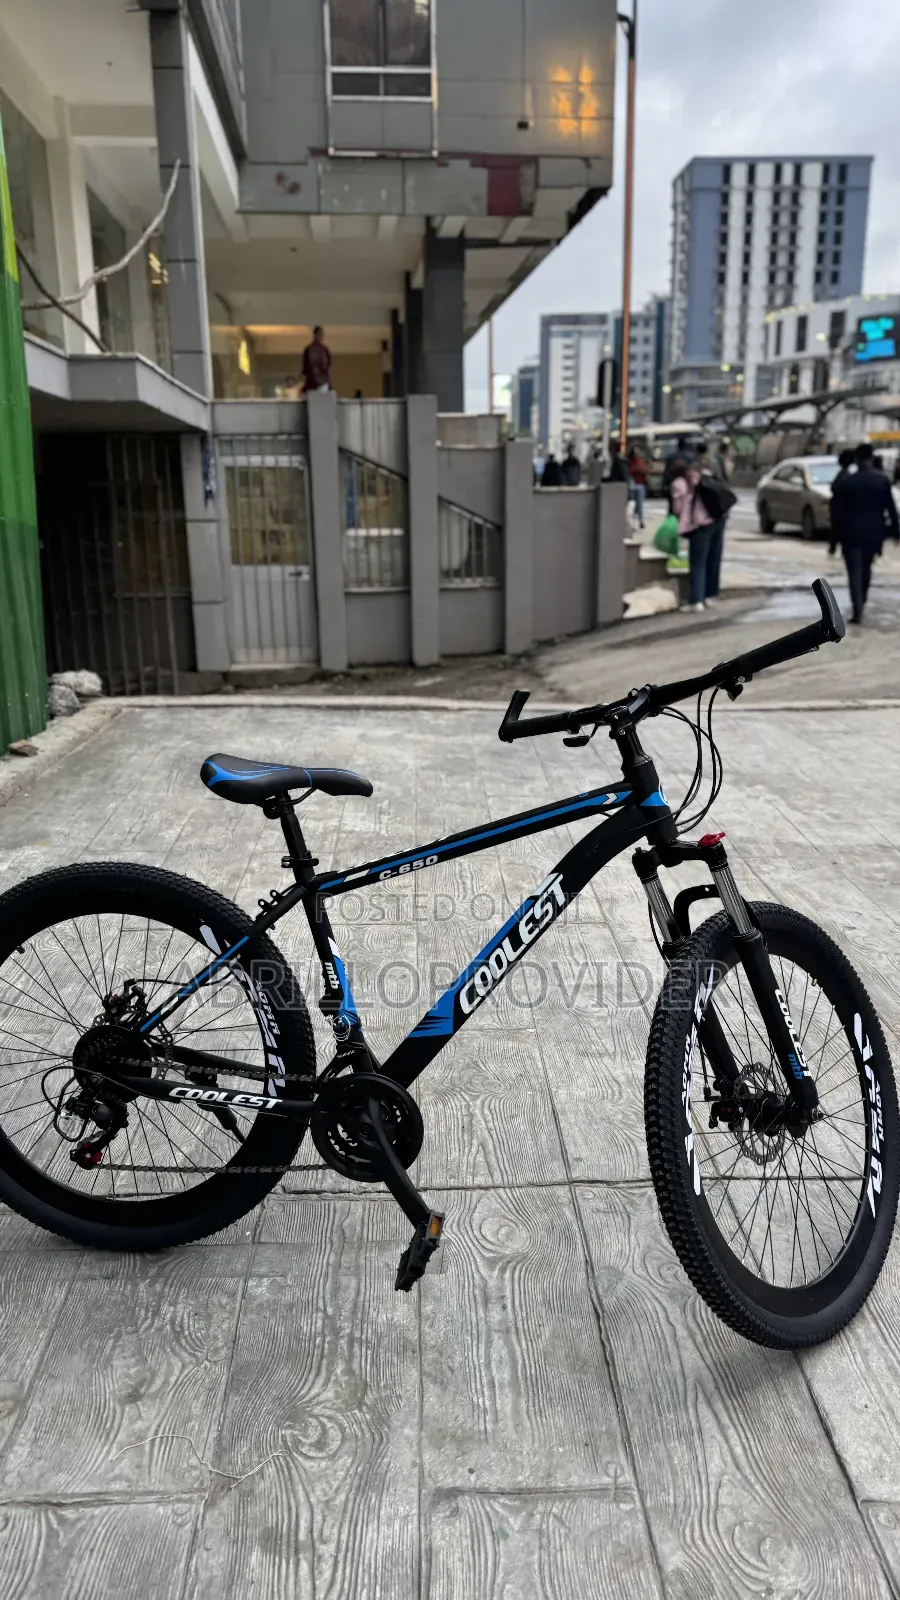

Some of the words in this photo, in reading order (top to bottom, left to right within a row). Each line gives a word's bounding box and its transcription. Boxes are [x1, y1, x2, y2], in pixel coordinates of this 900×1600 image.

[378, 854, 439, 881] C-650
[459, 872, 566, 1015] COOLEST
[324, 962, 340, 989] mtb
[787, 1053, 804, 1080] mtb
[168, 1087, 284, 1110] COOLEST
